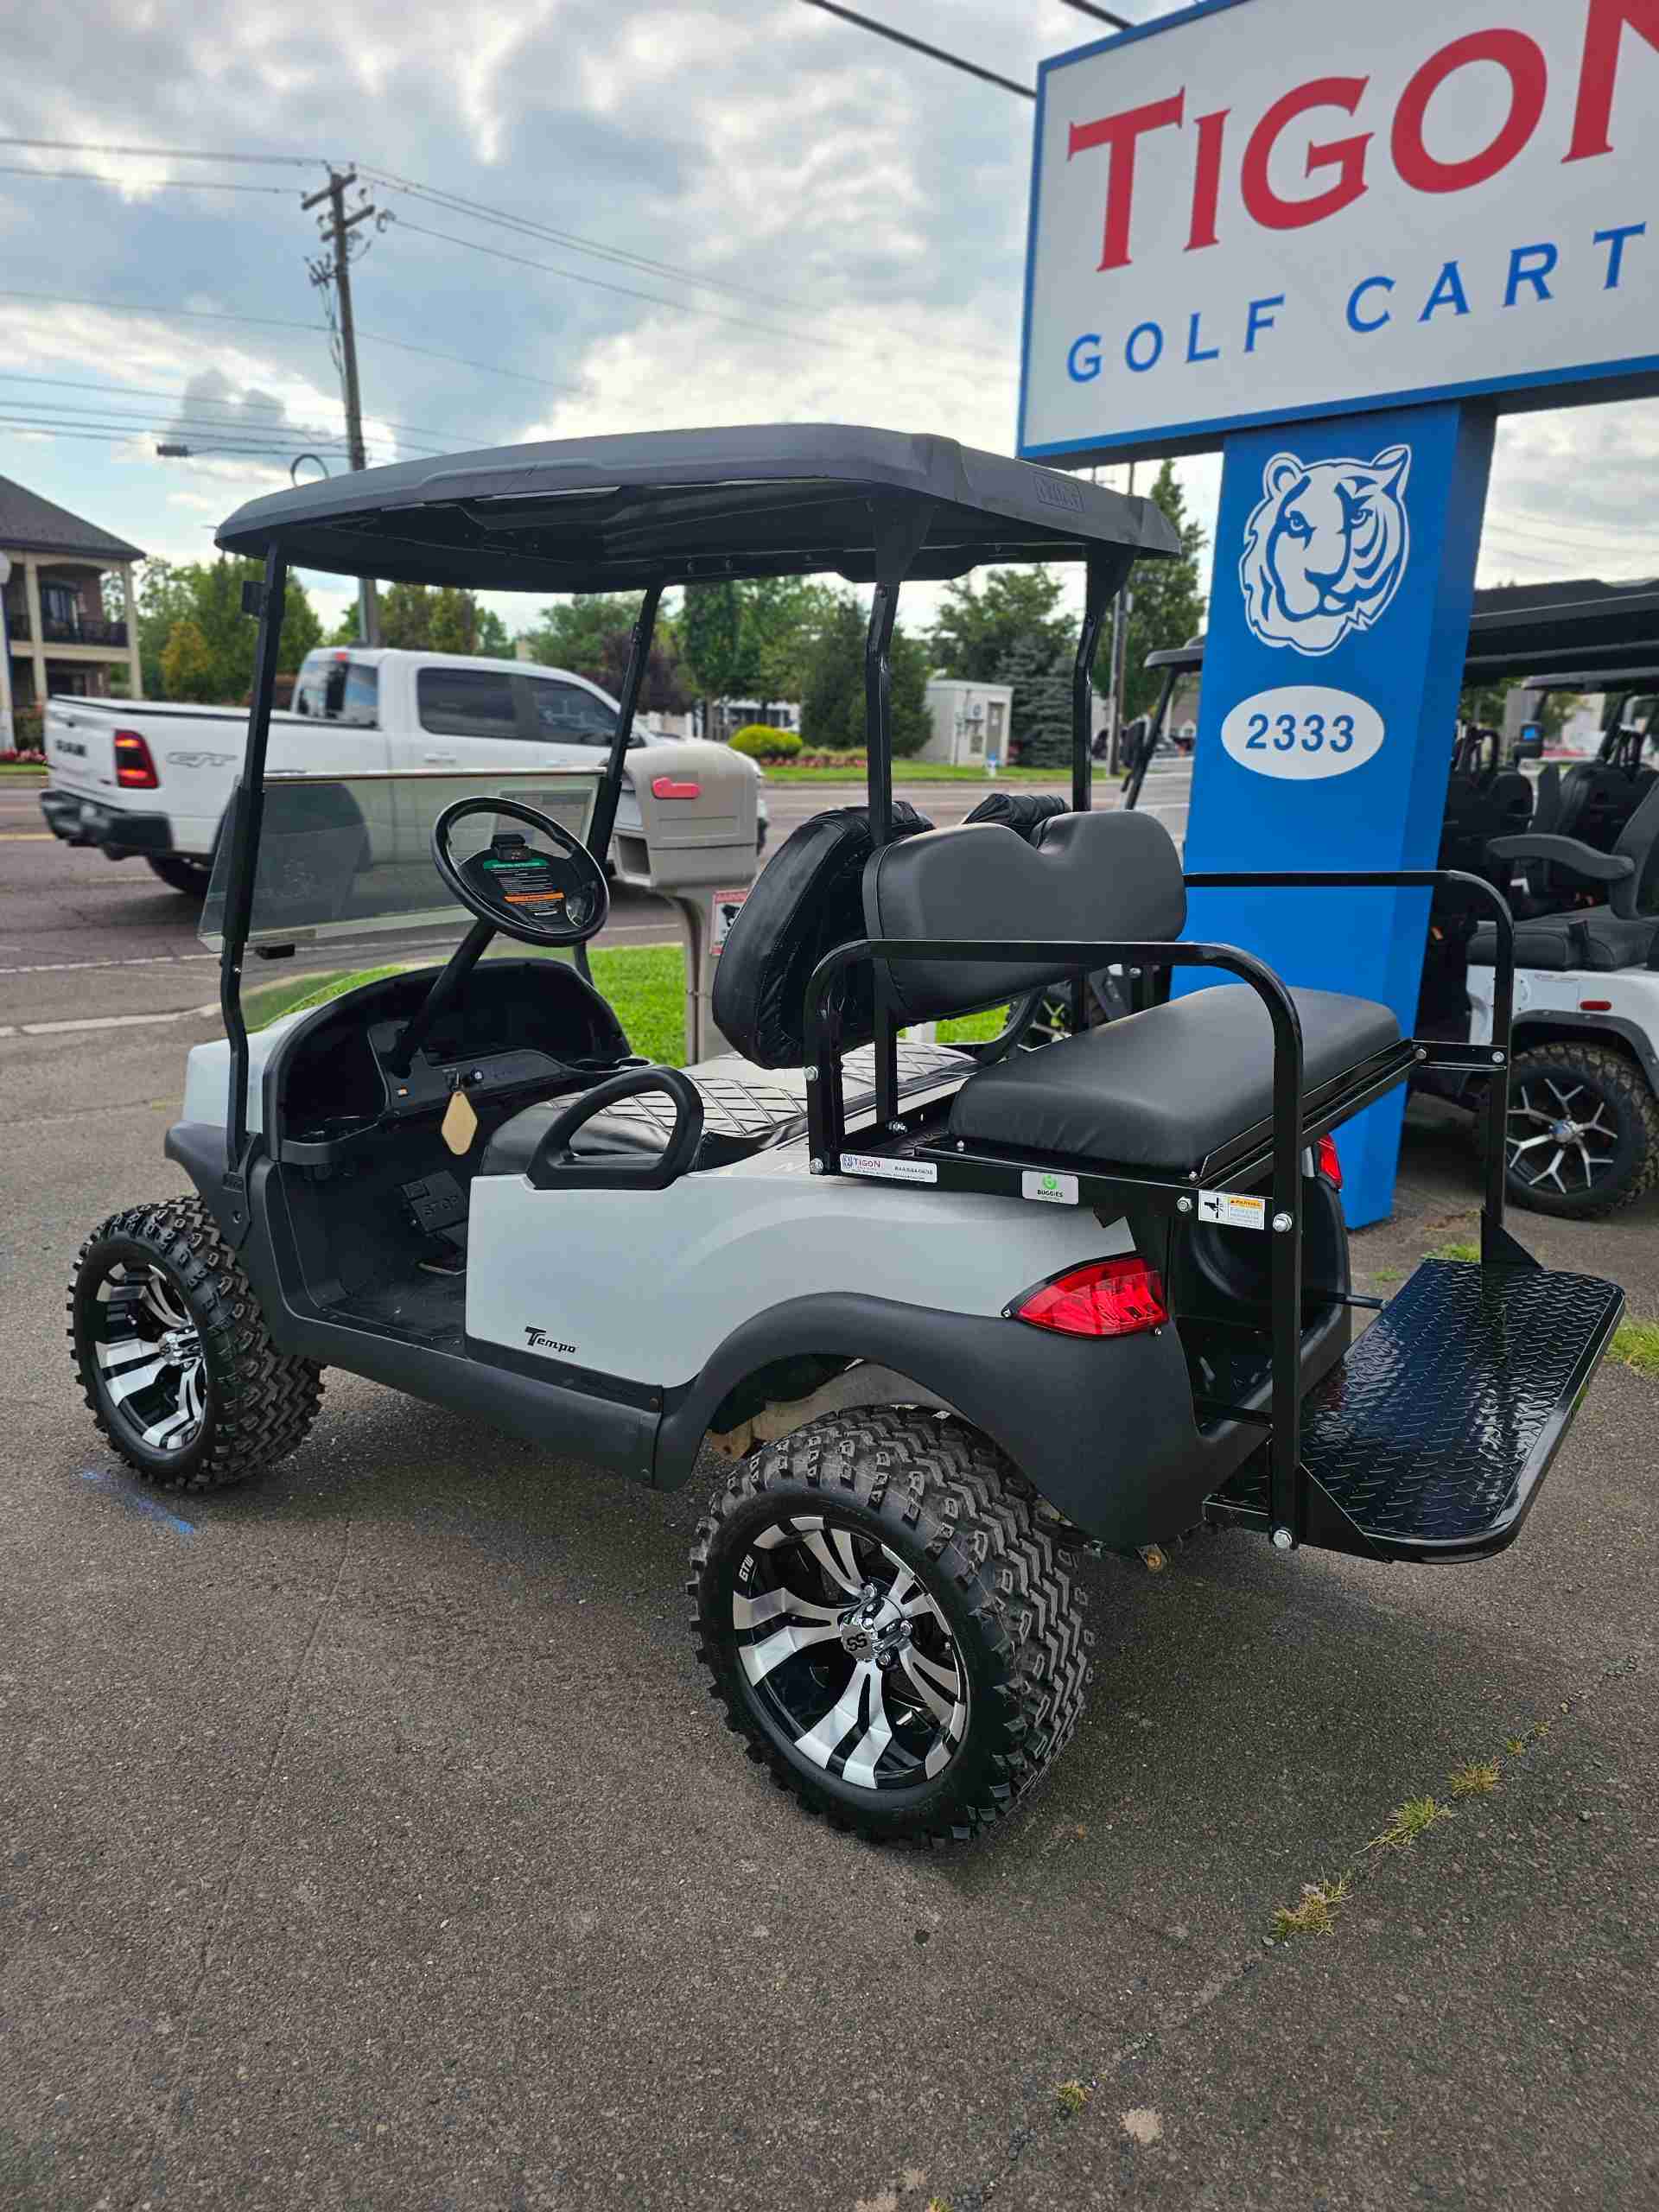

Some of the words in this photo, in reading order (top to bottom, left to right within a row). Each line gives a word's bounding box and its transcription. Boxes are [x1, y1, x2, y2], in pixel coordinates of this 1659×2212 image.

[1066, 294, 1286, 383] GOLF
[1345, 221, 1647, 334] CART
[1245, 713, 1355, 753] 2333
[525, 1325, 576, 1353] Tempo
[738, 1554, 754, 1582] GTW
[846, 1632, 868, 1652] SS
